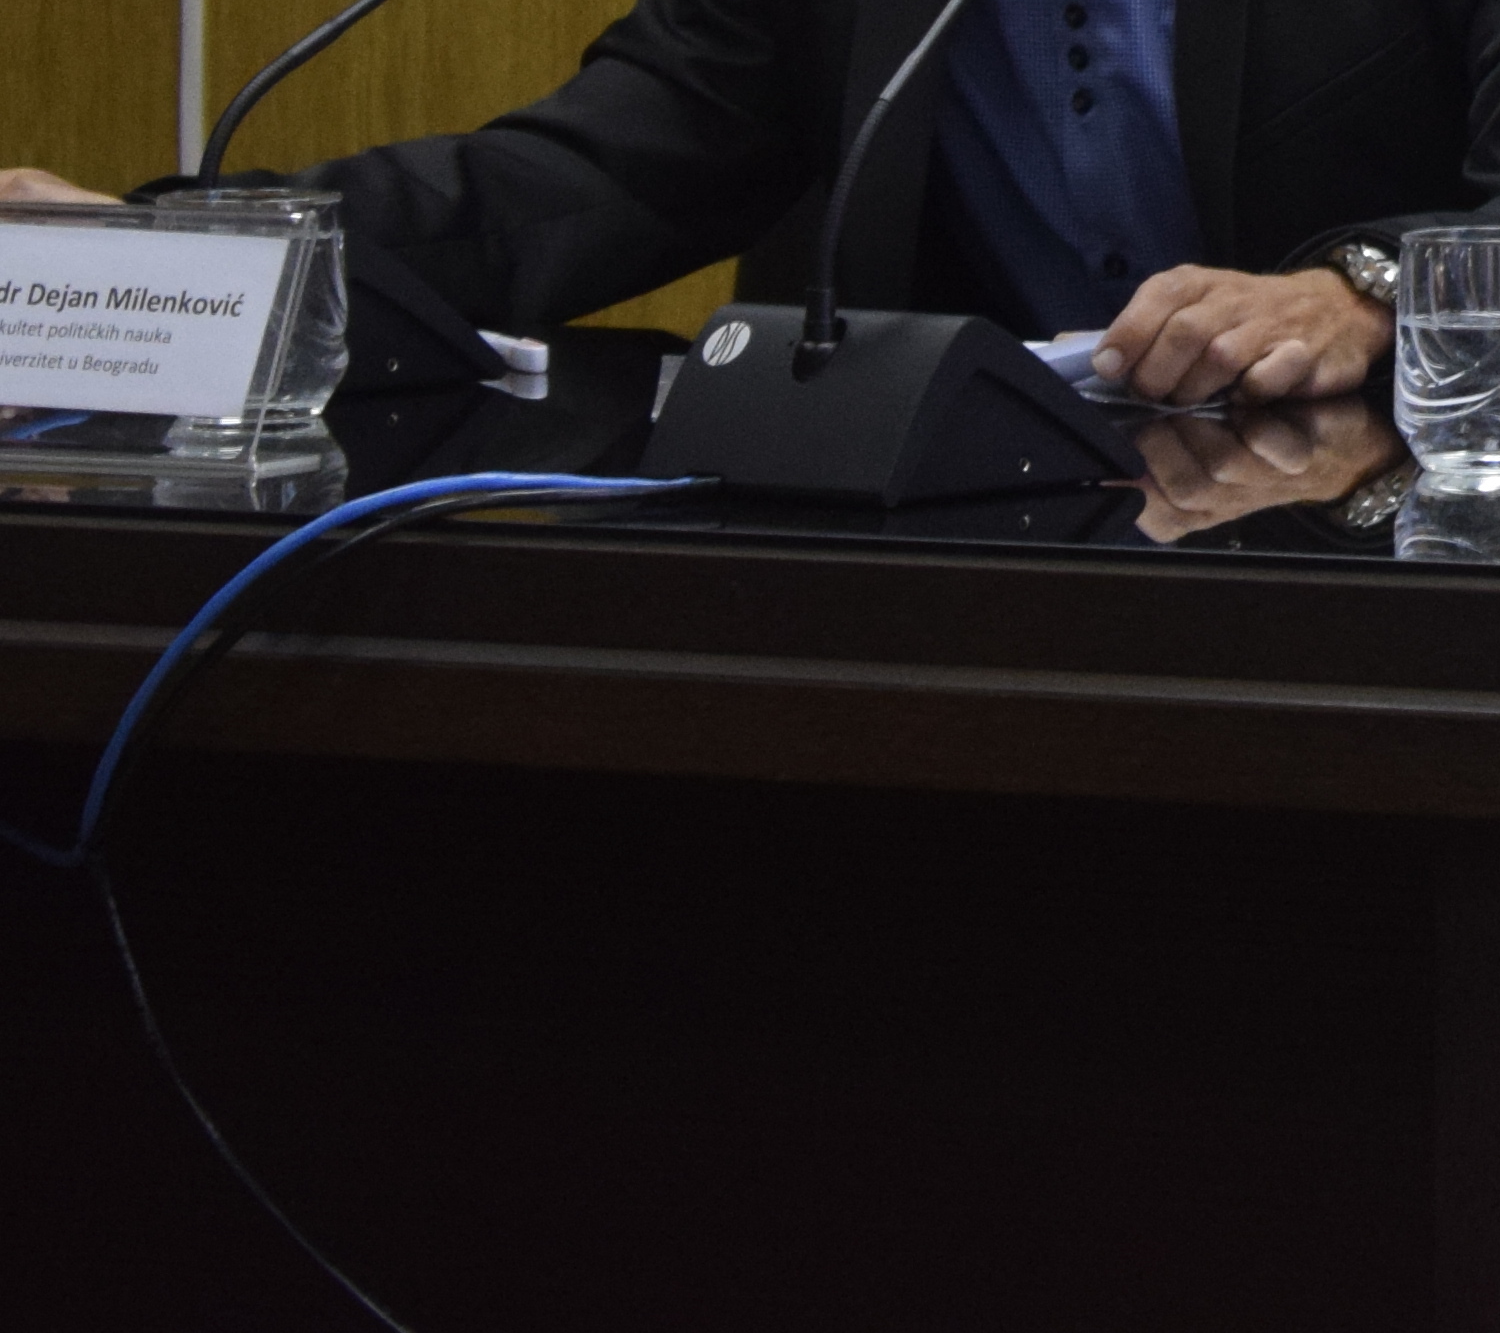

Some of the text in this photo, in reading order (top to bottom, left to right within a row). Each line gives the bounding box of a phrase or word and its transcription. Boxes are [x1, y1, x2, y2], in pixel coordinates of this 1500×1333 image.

[27, 283, 98, 313] Dejan
[106, 287, 245, 317] Milenković
[47, 322, 120, 342] političkih
[123, 330, 172, 345] nauka
[67, 359, 78, 371] u
[82, 355, 159, 377] Beogradu
